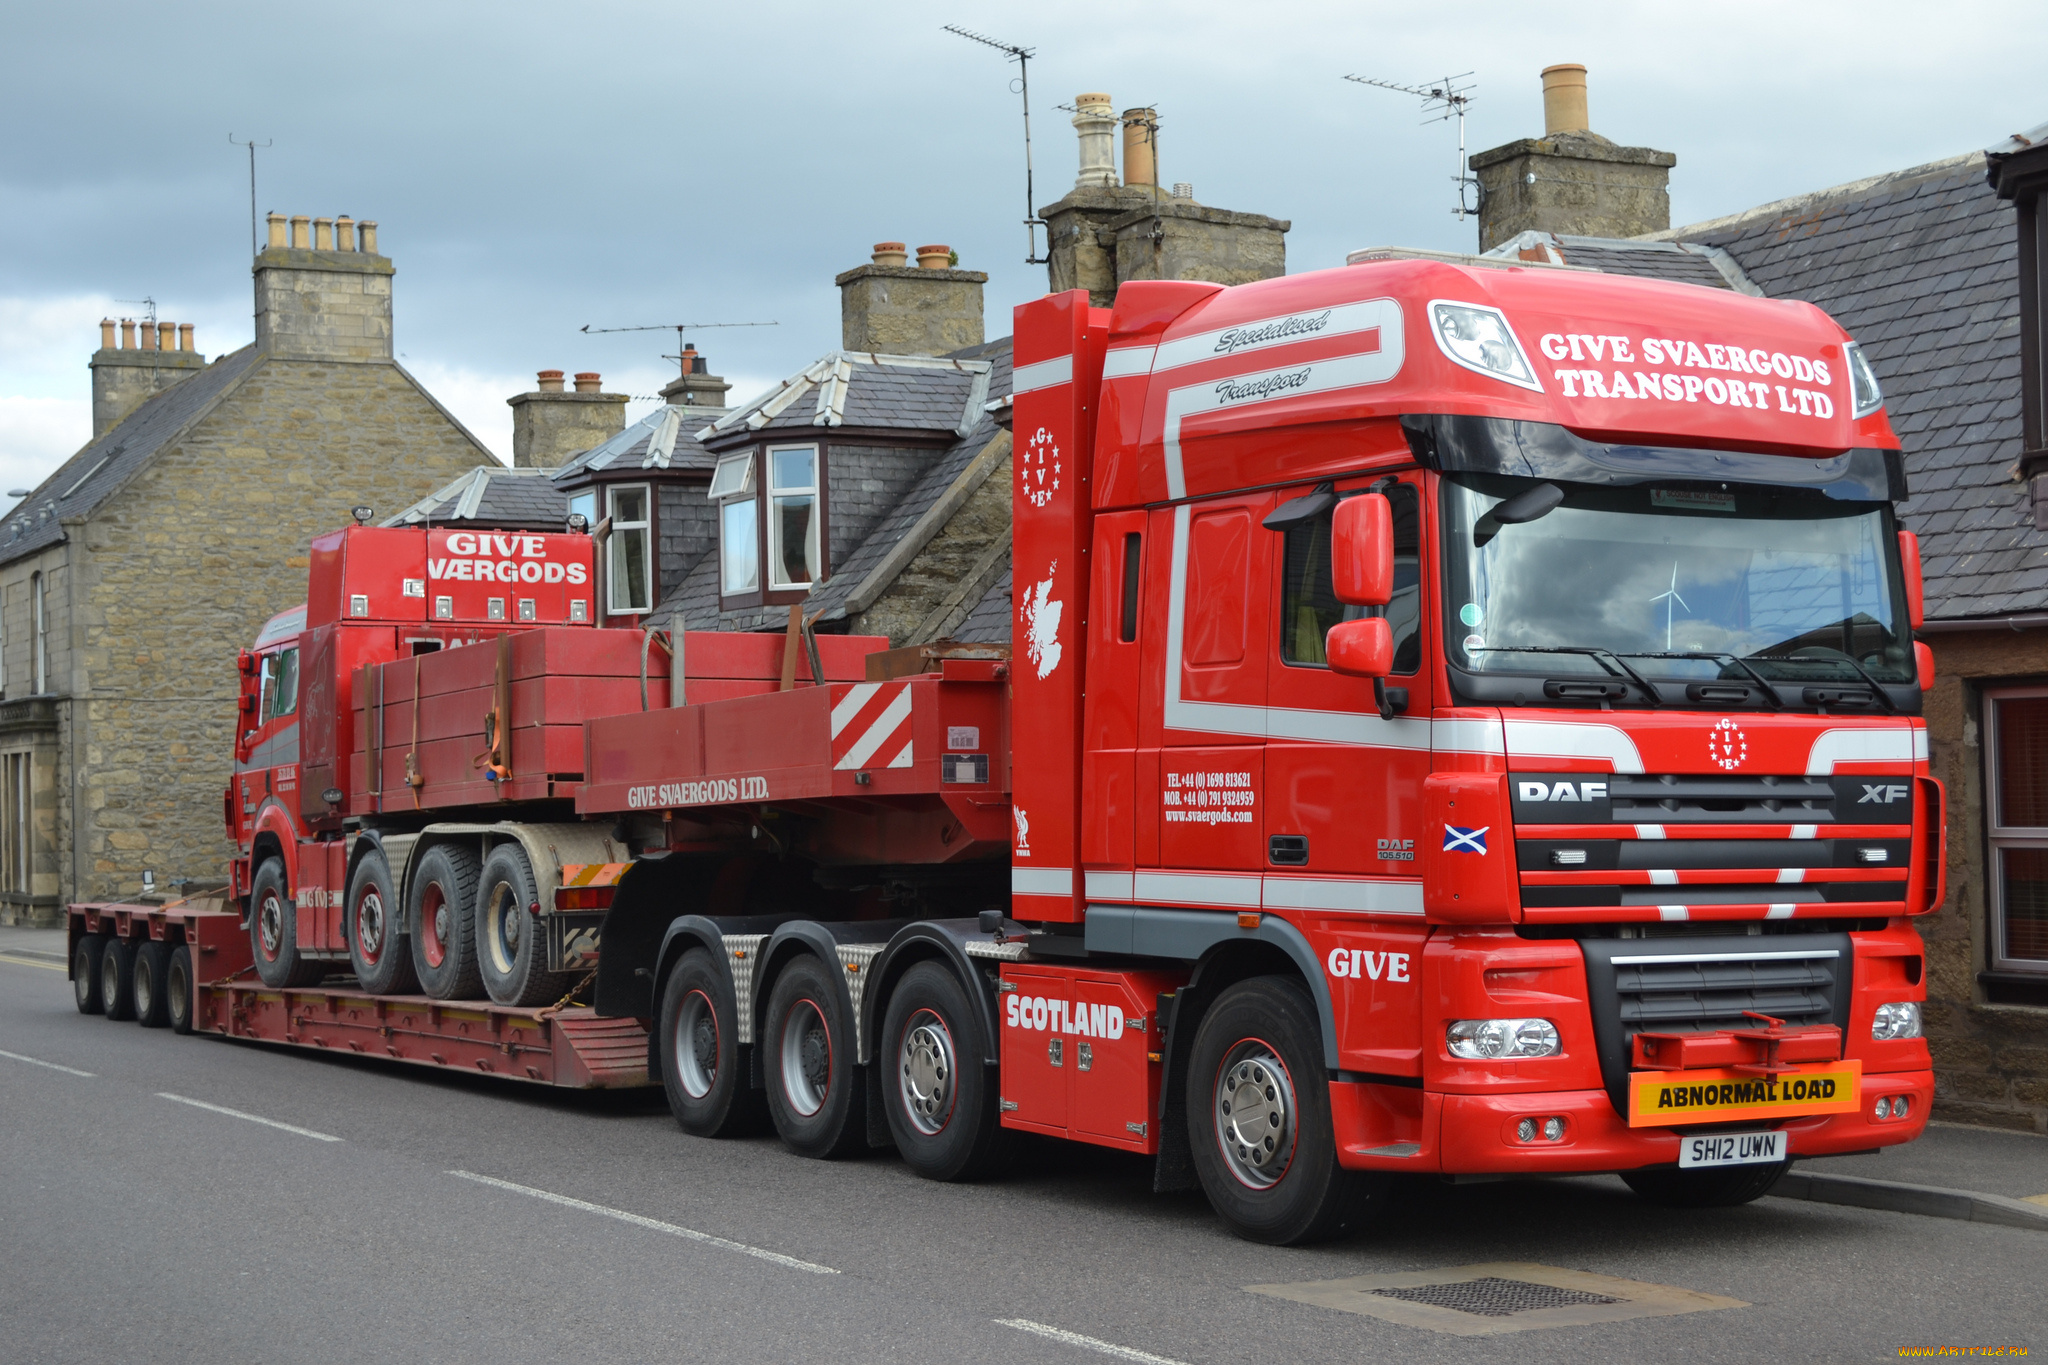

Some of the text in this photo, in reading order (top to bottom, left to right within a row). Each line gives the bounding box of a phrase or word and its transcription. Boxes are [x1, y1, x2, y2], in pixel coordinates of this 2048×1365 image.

[1214, 310, 1331, 353] Specialised
[1540, 333, 1832, 386] GIVE SVAERGODS
[1215, 367, 1311, 404] Transport
[1554, 369, 1834, 419] TRANSPORT LTD
[1036, 427, 1046, 507] GIVE
[446, 533, 546, 558] GIVE
[1721, 718, 1733, 770] GIVE
[628, 776, 769, 808] GIVE SVAERGODS LTD.
[1195, 771, 1205, 789] (0)
[1207, 772, 1224, 787] 1698
[1225, 772, 1251, 787] 813621
[1518, 781, 1607, 802] DAF
[1857, 784, 1908, 803] XF
[1163, 789, 1255, 807] MOB. +44 (0) 791 9324959
[1165, 806, 1253, 826] www.svaergods.com
[1377, 839, 1414, 850] DAF
[1378, 851, 1413, 860] 105.510
[1328, 947, 1410, 983] GIVE
[1007, 994, 1124, 1040] SCOTLAND
[1658, 1079, 1836, 1108] ABNORMAL LOAD
[1692, 1135, 1776, 1162] SH12 UWN
